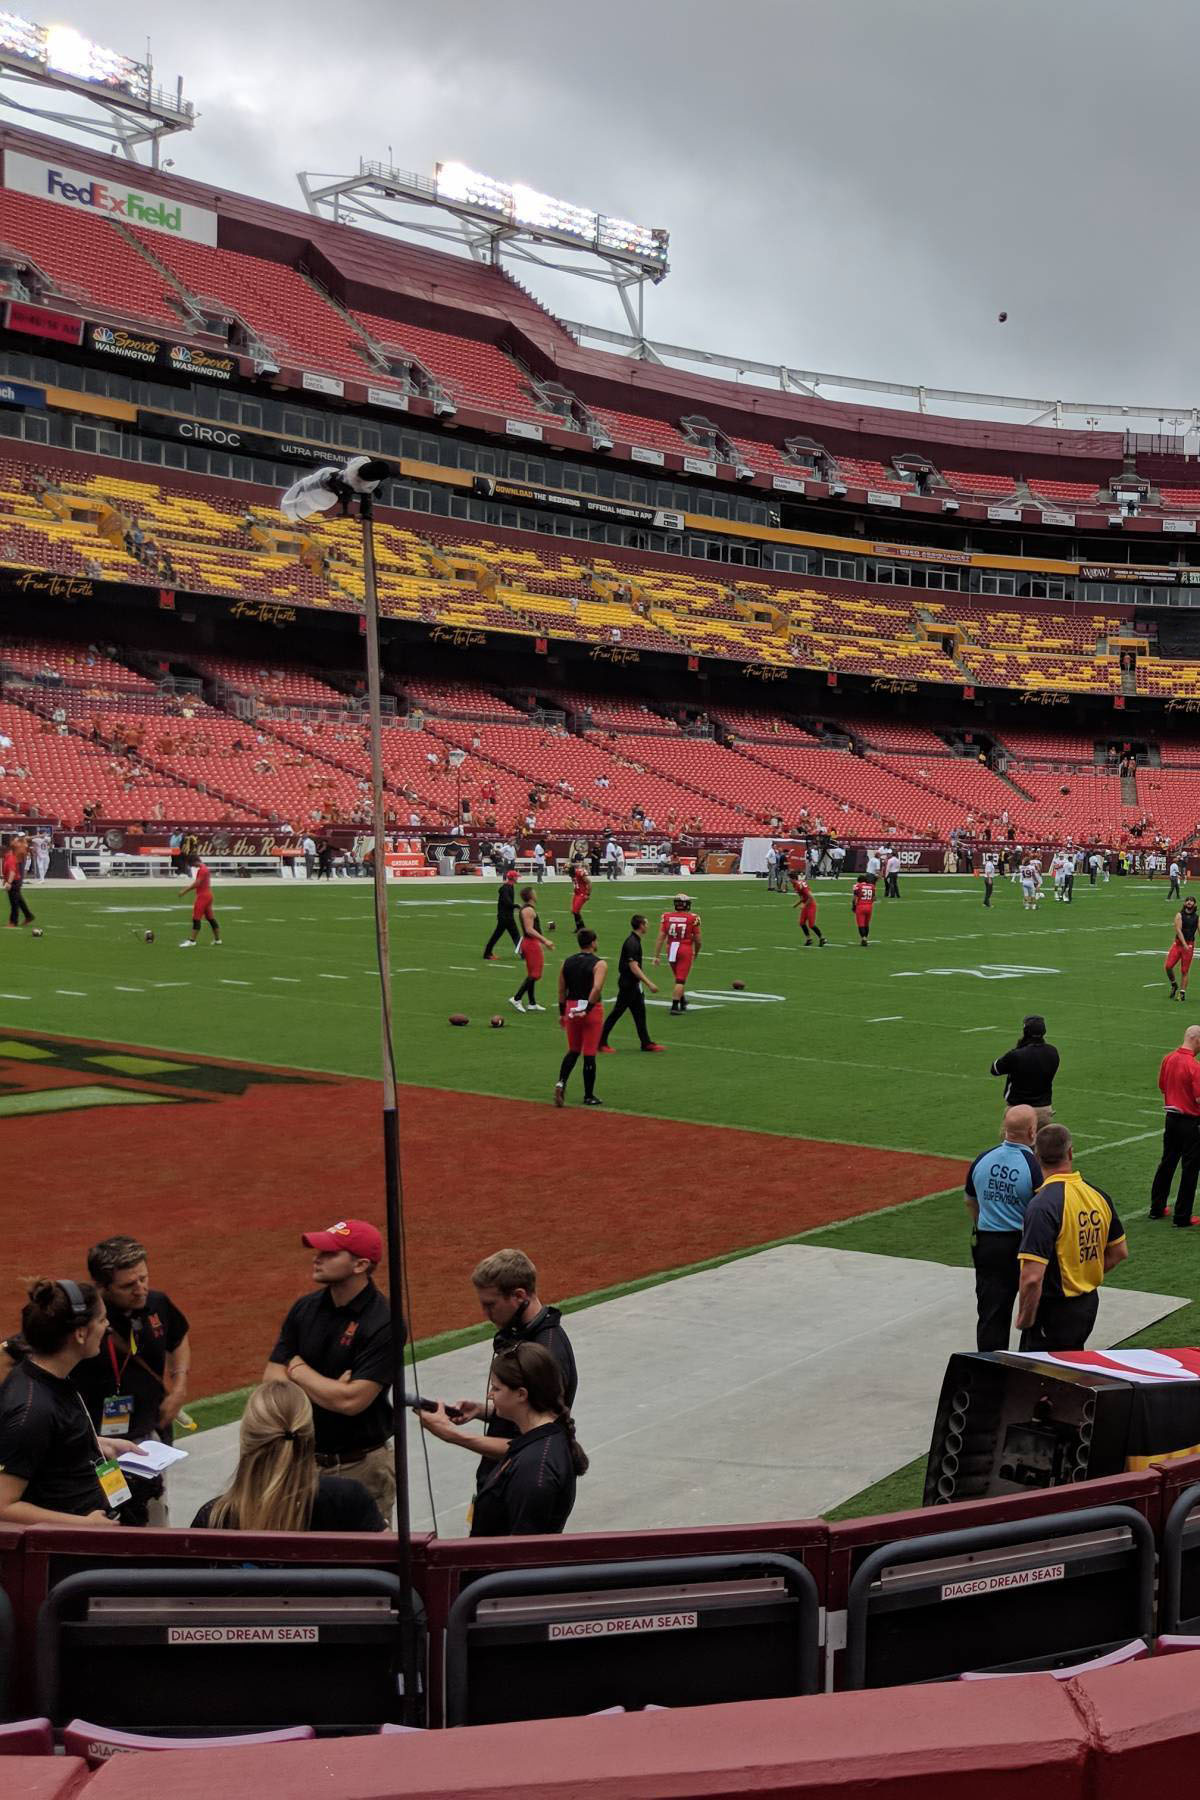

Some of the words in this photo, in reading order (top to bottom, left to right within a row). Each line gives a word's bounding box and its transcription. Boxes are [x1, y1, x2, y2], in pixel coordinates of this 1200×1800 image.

[47, 169, 181, 231] FedExField
[95, 341, 156, 363] WASHINGTON
[114, 331, 160, 354] Sports
[172, 360, 230, 379] WASHINGTON
[191, 350, 234, 370] Sports
[281, 444, 311, 456] ULTRA
[495, 486, 533, 498] DOWNLOAD
[534, 492, 547, 501] THE
[587, 503, 615, 514] OFFICIAL
[616, 508, 639, 518] MOBILE
[640, 512, 653, 520] APP
[232, 834, 257, 858] the
[668, 923, 687, 939] 47
[990, 1163, 1020, 1182] CSC
[987, 1178, 1017, 1195] EVENT
[944, 1581, 987, 1598] DIAGEO
[990, 1573, 1029, 1589] DREAM
[1032, 1566, 1063, 1581] SEATS
[171, 1630, 223, 1641] DIAGEO
[227, 1629, 274, 1641] DREAM
[278, 1629, 316, 1640] SEATS
[552, 1623, 604, 1637] DIAGEO
[607, 1619, 654, 1633] DREAM
[658, 1615, 695, 1627] SEATS
